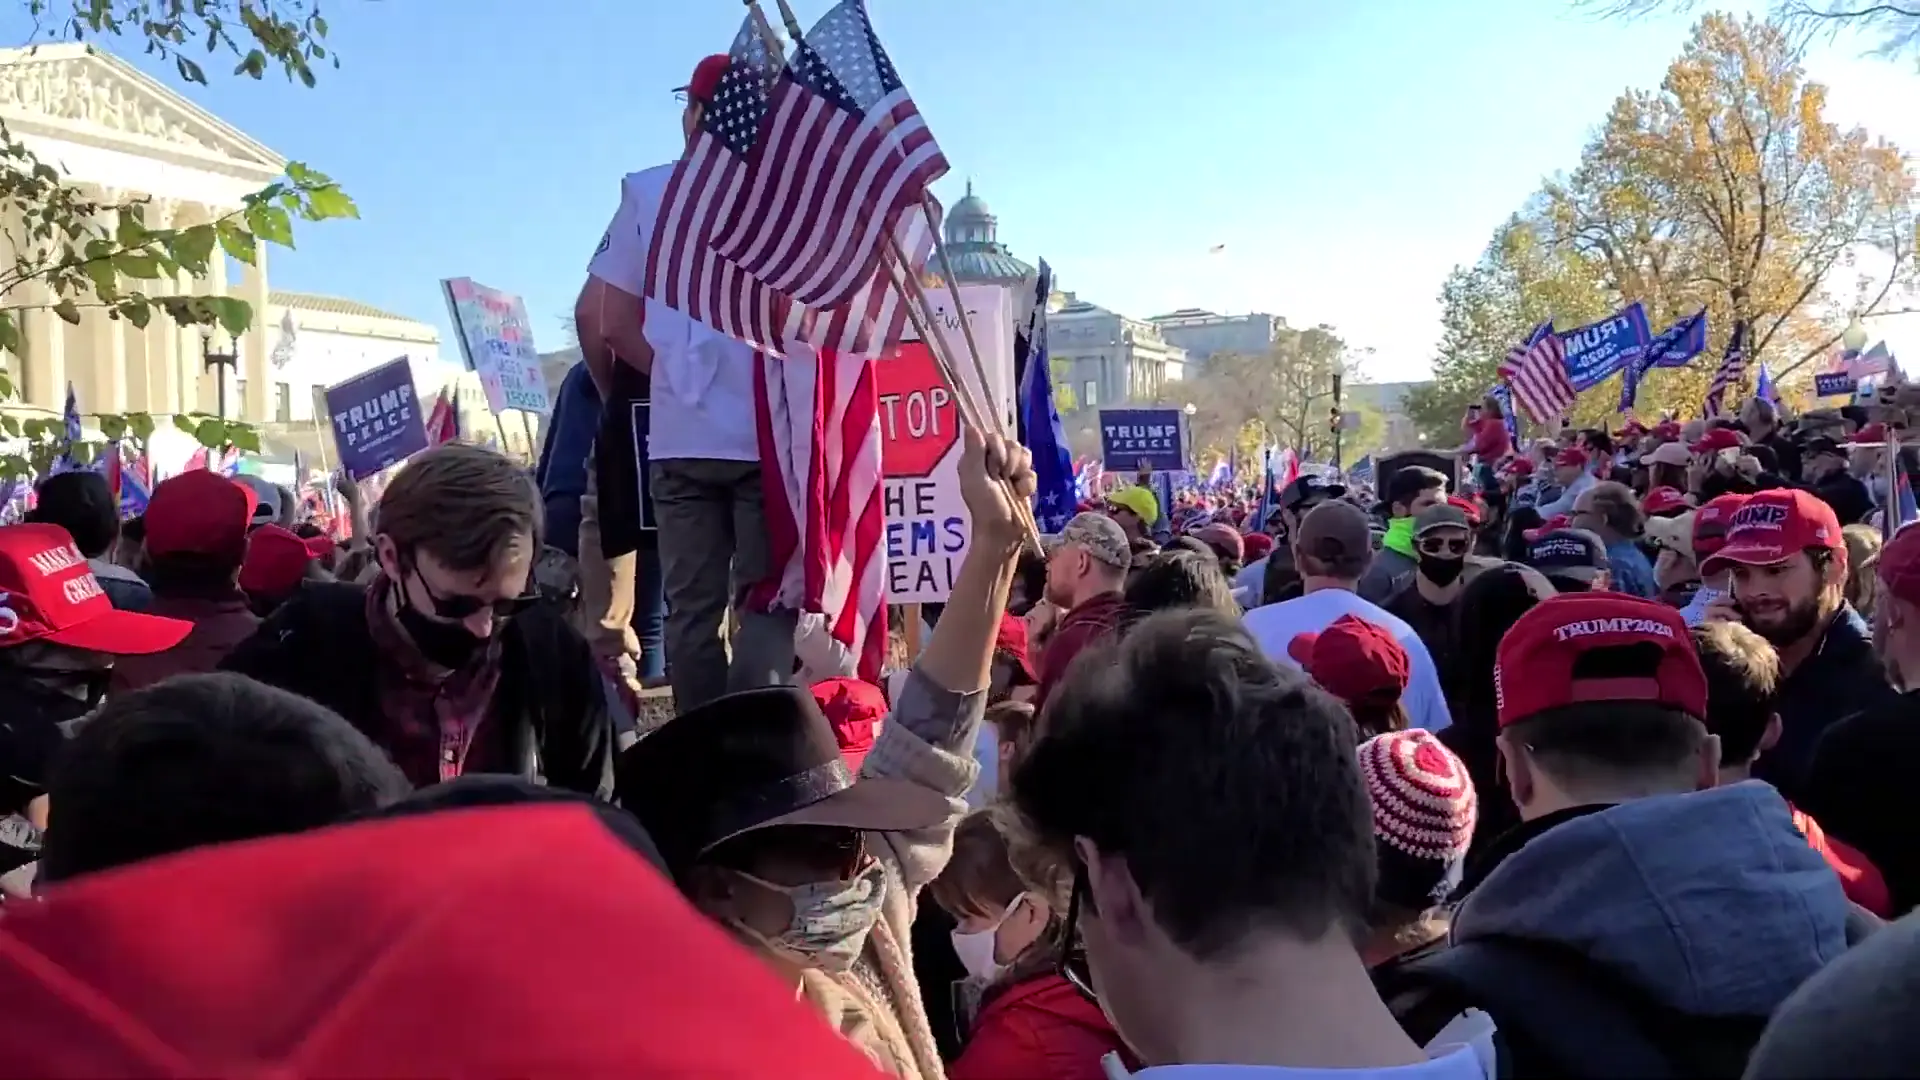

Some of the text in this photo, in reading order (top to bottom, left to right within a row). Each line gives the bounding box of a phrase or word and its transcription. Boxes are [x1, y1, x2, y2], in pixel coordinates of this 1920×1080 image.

[334, 384, 411, 433] TRUMP
[347, 407, 411, 446] PENCE
[880, 385, 951, 440] TOP
[1105, 425, 1177, 438] TRUMP
[1113, 439, 1171, 449] PENCE
[885, 482, 936, 516] HE
[887, 516, 965, 557] EMS
[889, 557, 953, 593] EAL
